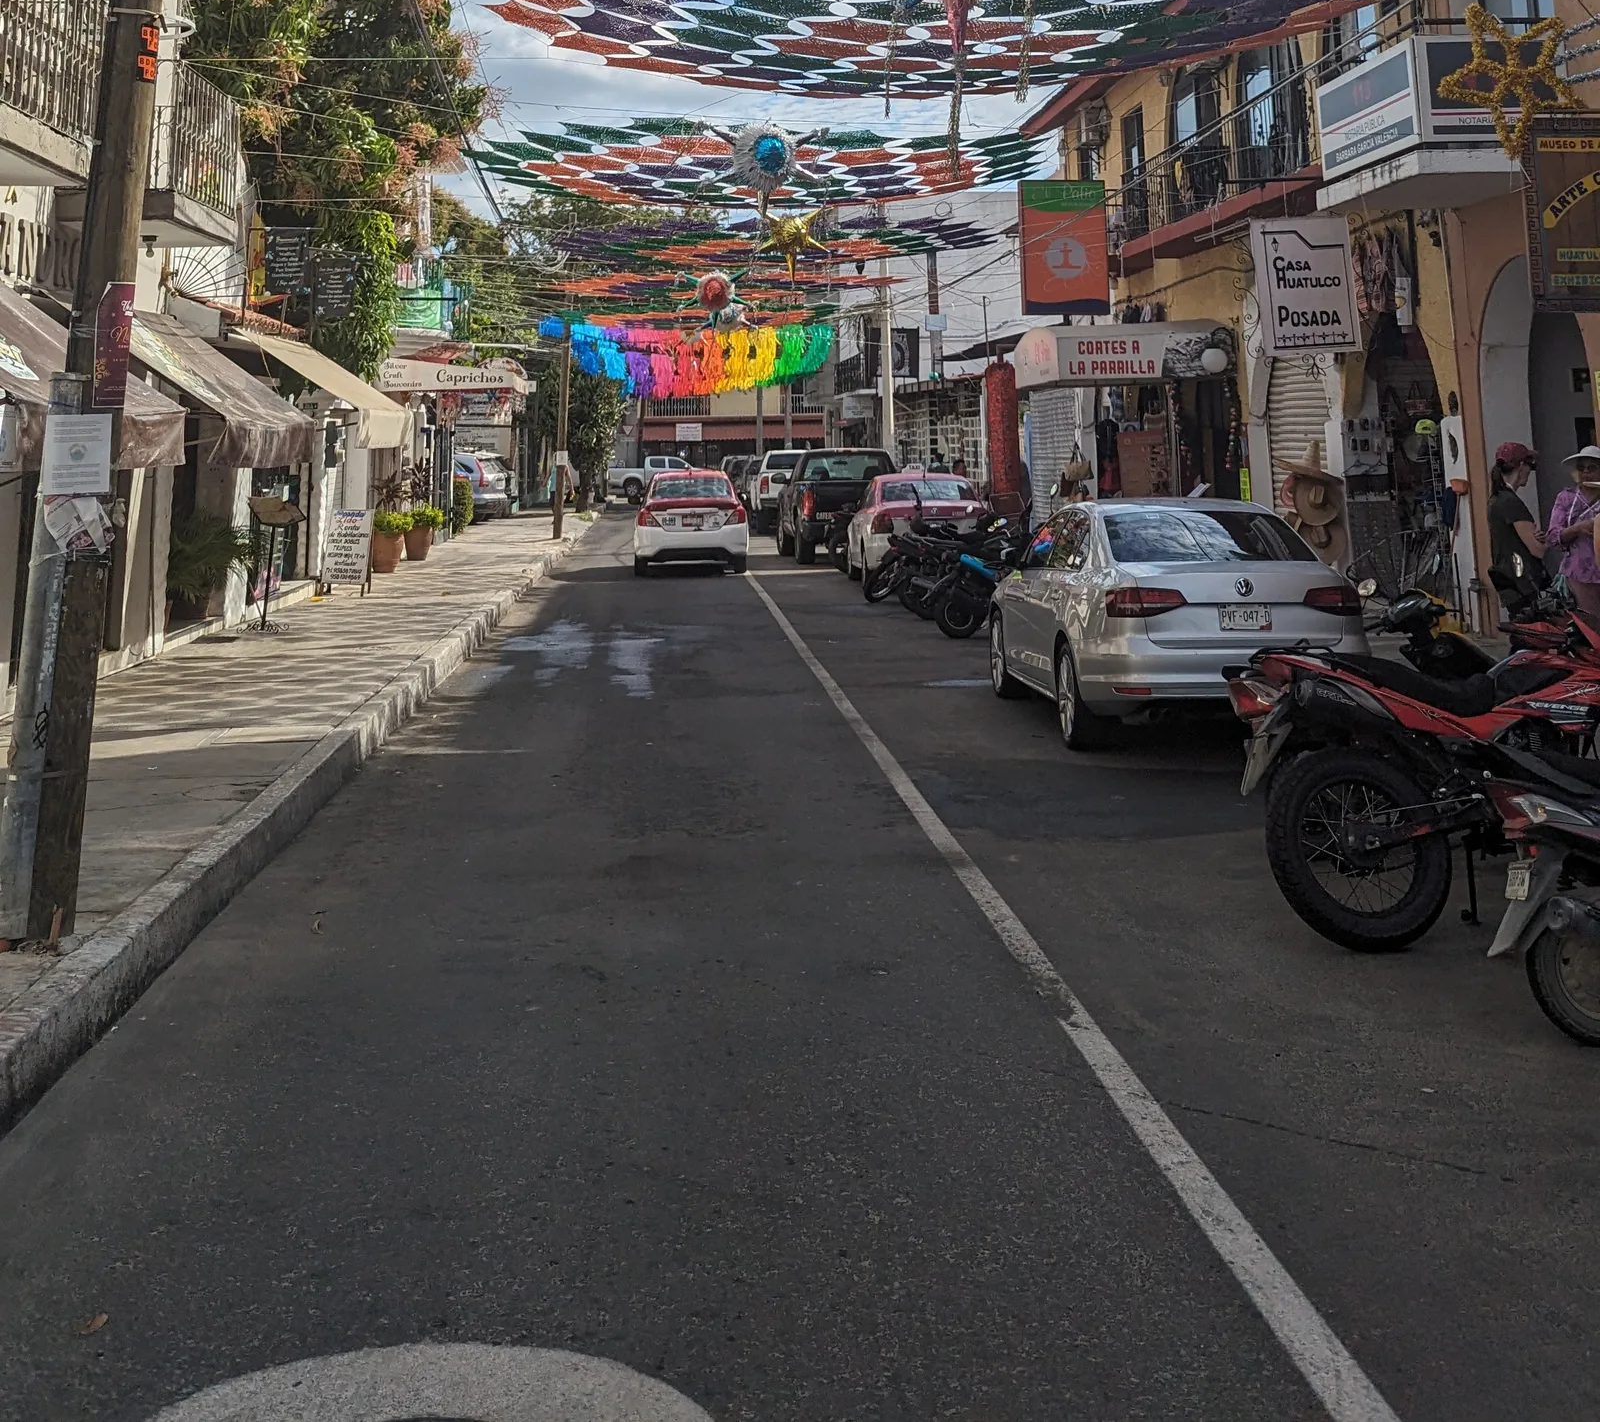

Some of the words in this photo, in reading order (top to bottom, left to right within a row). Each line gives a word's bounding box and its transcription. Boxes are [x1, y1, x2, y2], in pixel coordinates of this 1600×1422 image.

[1539, 139, 1577, 149] MUSEO
[1580, 139, 1595, 149] DE
[1549, 180, 1589, 219] ARTE
[1272, 256, 1312, 272] CASA
[1275, 268, 1341, 289] HUATULCO
[1277, 305, 1342, 327] POSADA
[1077, 340, 1127, 355] CORTES
[1131, 340, 1140, 355] A
[383, 362, 407, 370] Silver
[1069, 361, 1086, 375] LA
[1091, 360, 1156, 375] PARRILLA
[383, 371, 403, 379] Craft
[436, 369, 504, 386] Caprichos
[383, 380, 422, 389] Souvenirs
[1221, 610, 1270, 623] PVF-047-D
[1526, 701, 1590, 712] REVENGE
